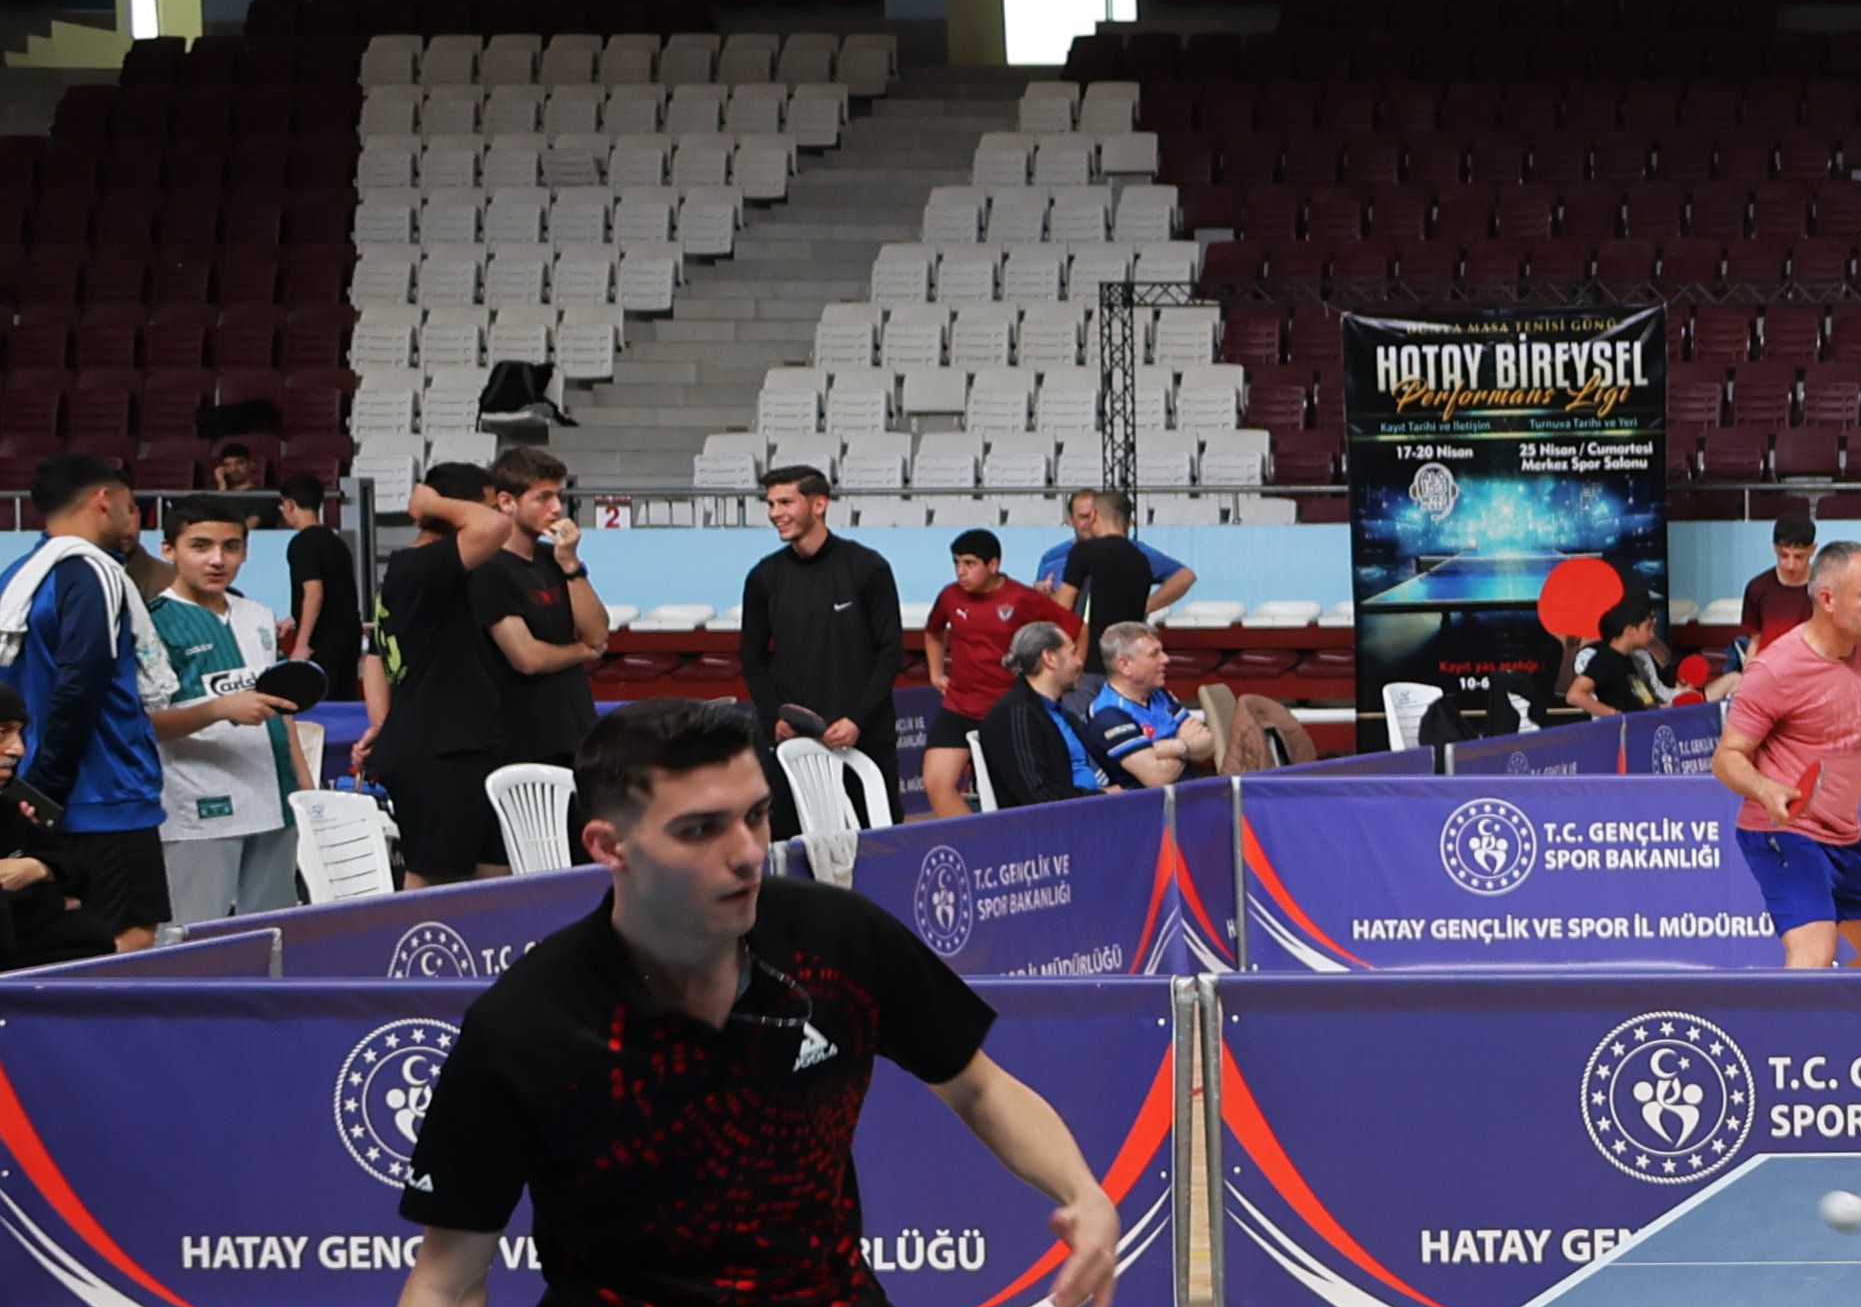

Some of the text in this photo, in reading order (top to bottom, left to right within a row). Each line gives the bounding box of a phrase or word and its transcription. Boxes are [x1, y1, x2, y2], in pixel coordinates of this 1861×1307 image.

[1467, 322, 1509, 333] MASA
[1376, 332, 1649, 393] HATAY BİREYSEL
[1391, 376, 1556, 422] Performans
[1396, 444, 1475, 460] 17-20 Nisan
[1519, 443, 1537, 457] 25
[1540, 442, 1577, 456] Nisan
[1587, 439, 1654, 455] Cumartesi
[1521, 456, 1649, 473] Merkez Spor Salonu
[605, 505, 621, 528] 2
[1543, 817, 1720, 847] T.C. GENÇLİK VE
[999, 853, 1071, 887] GENÇLİK VE
[1543, 844, 1720, 870] SPOR BAKANLIĞI
[976, 893, 1008, 921] SPOR
[1352, 912, 1654, 945] HATAY GENÇLİK VE SPOR İL
[792, 1042, 839, 1073] JOOLA
[1768, 1056, 1838, 1090] T.C.
[181, 1235, 307, 1270] HATAY
[1421, 1229, 1551, 1264] HATAY
